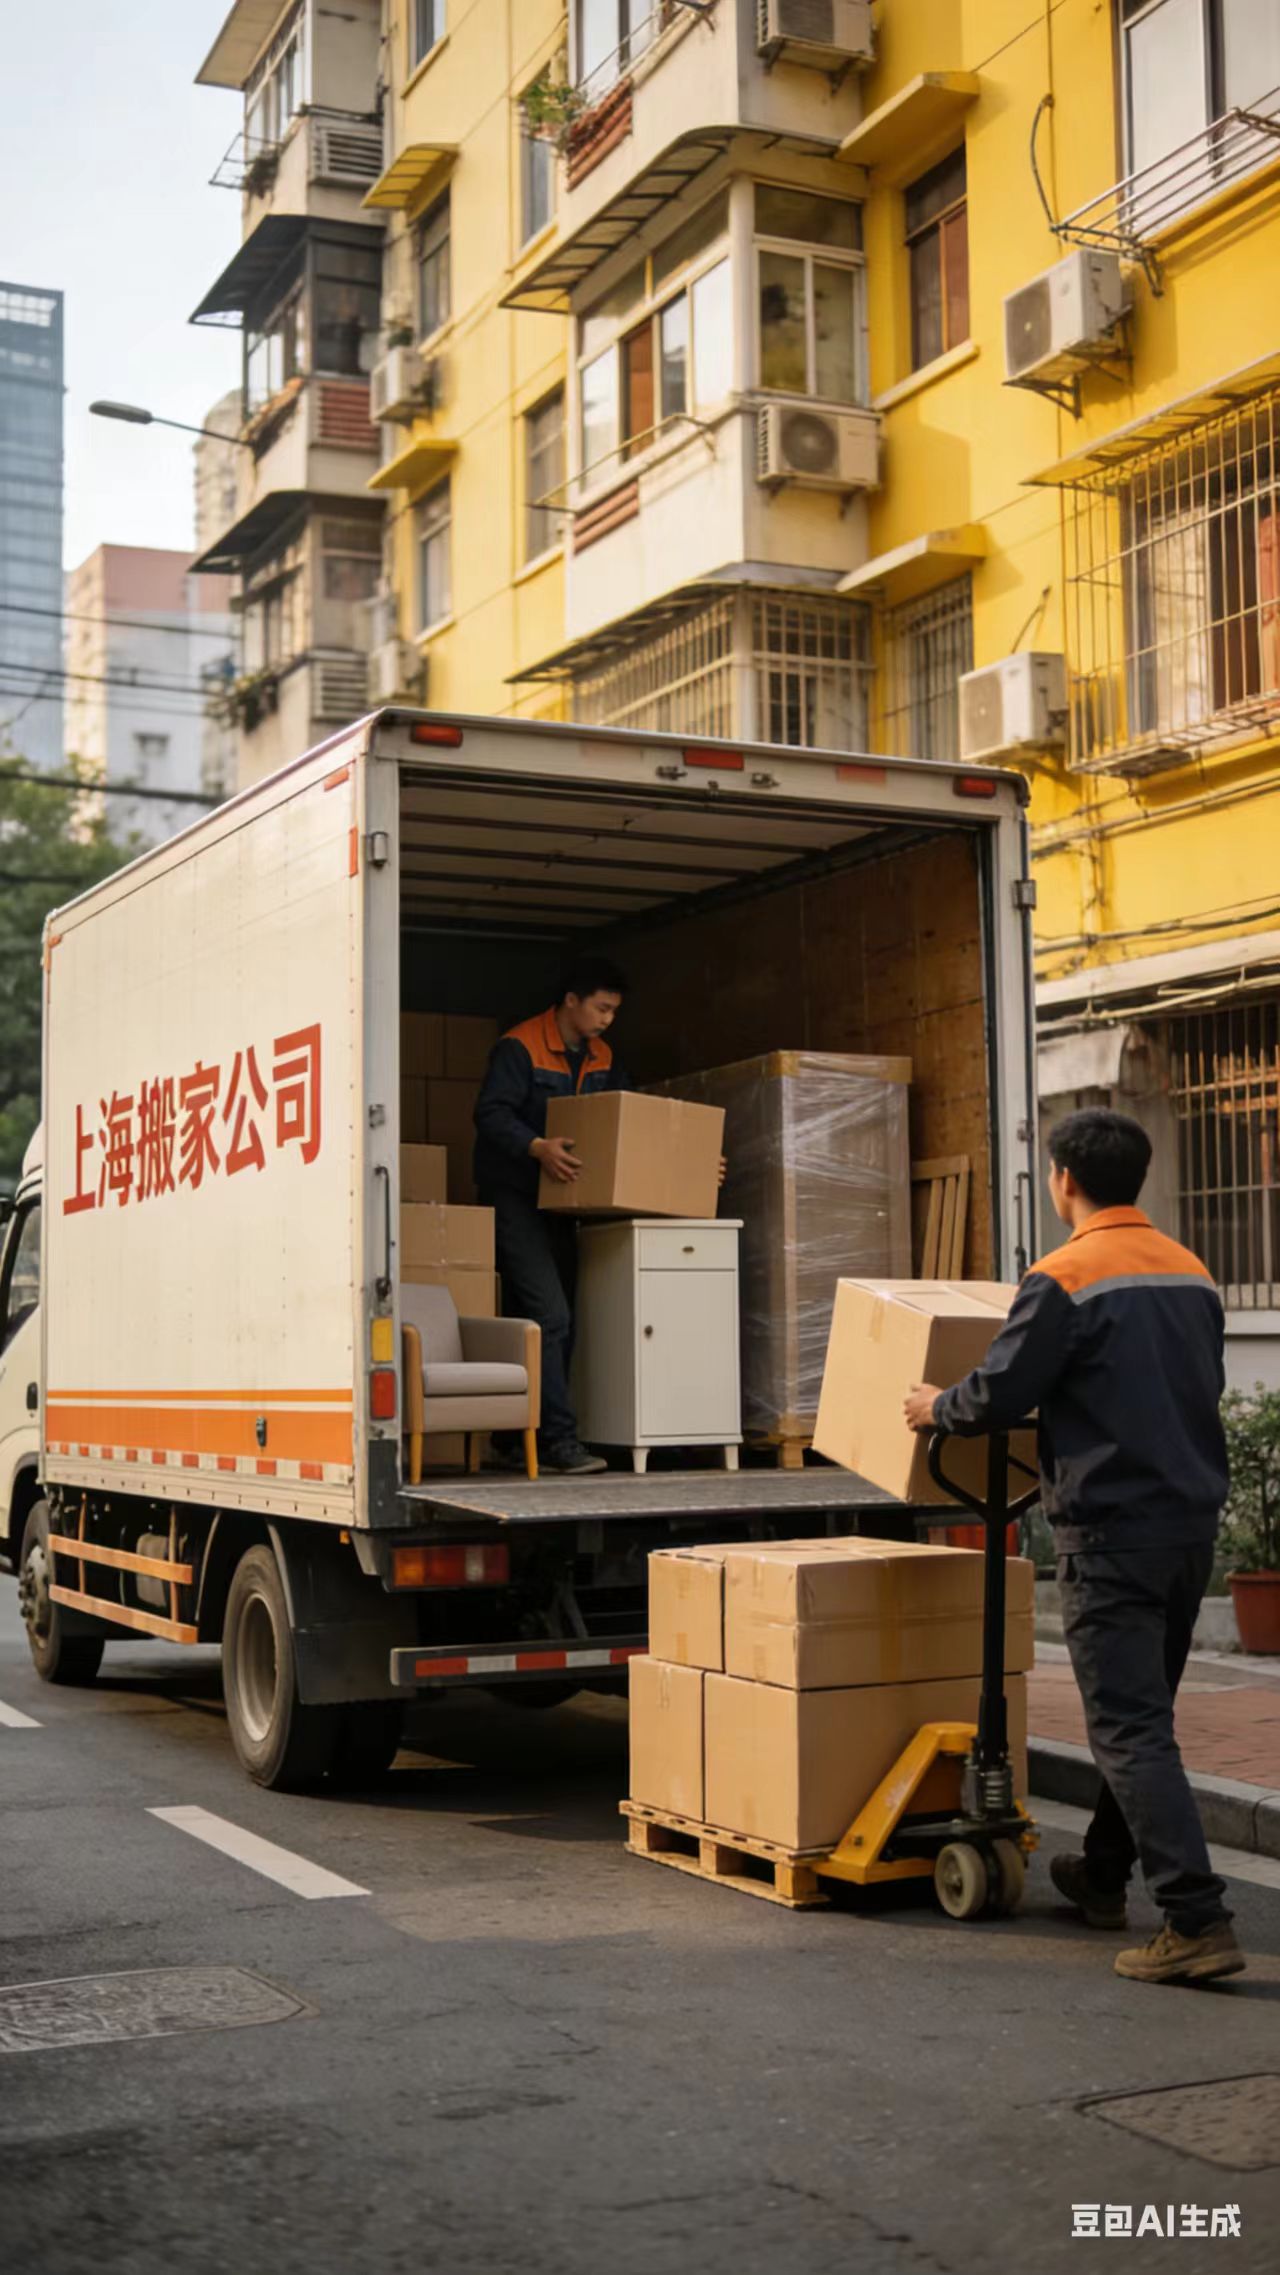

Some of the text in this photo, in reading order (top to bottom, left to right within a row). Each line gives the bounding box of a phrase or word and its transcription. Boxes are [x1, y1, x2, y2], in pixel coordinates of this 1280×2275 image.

[63, 1023, 321, 1216] 上海搬家公司
